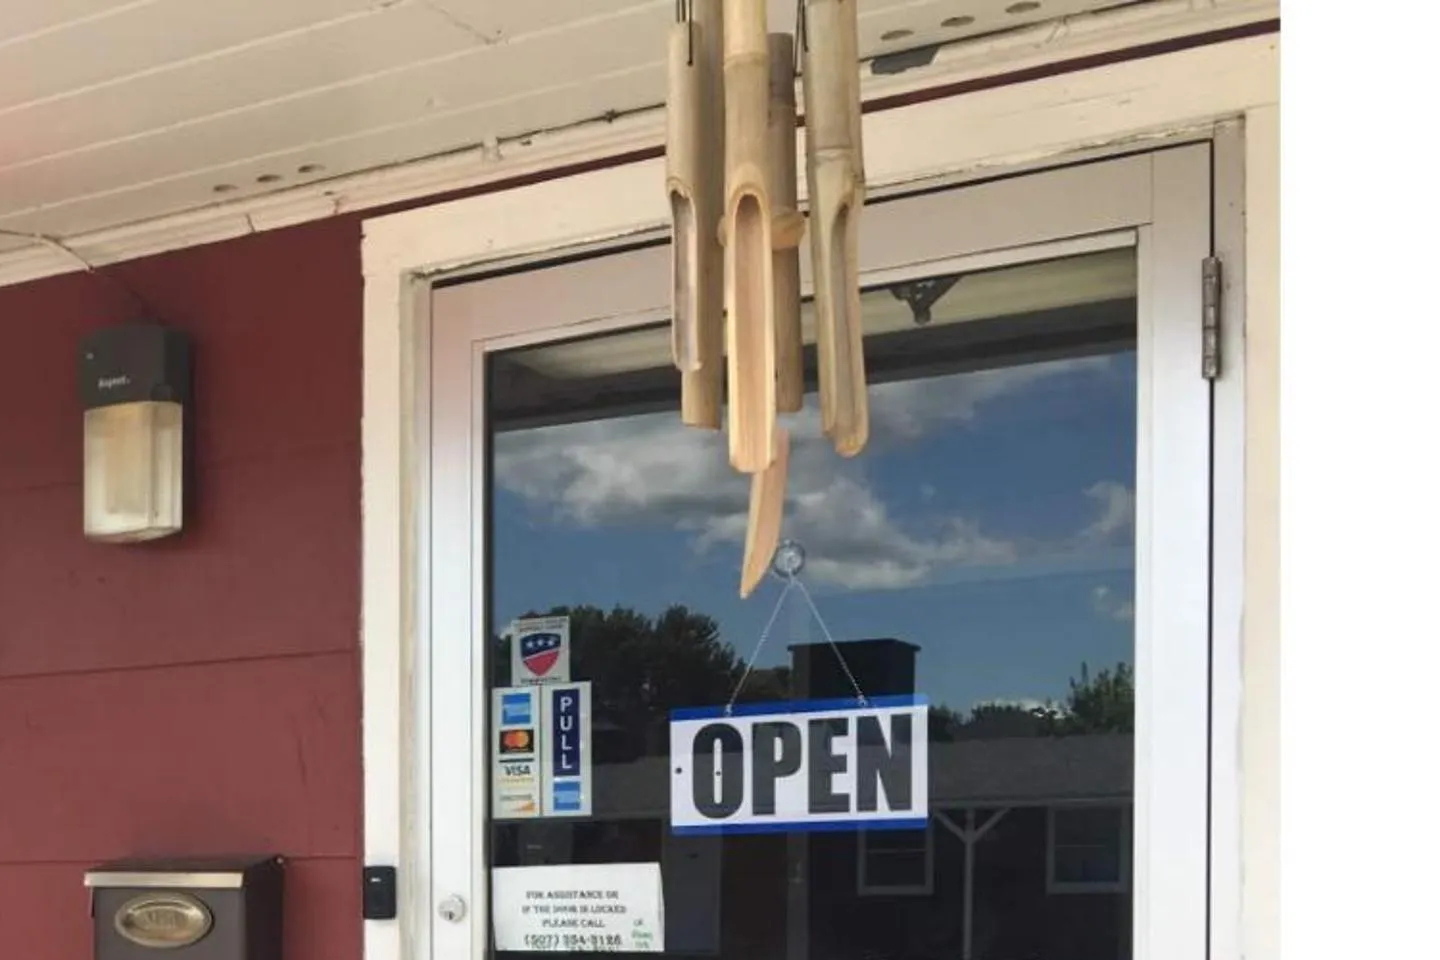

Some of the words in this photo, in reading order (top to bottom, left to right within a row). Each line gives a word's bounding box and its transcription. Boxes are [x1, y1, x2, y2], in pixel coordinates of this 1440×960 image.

[560, 696, 573, 769] PULL
[504, 765, 531, 776] VISA
[692, 713, 913, 819] OPEN
[542, 918, 578, 928] PLEASE
[580, 918, 606, 928] CALL
